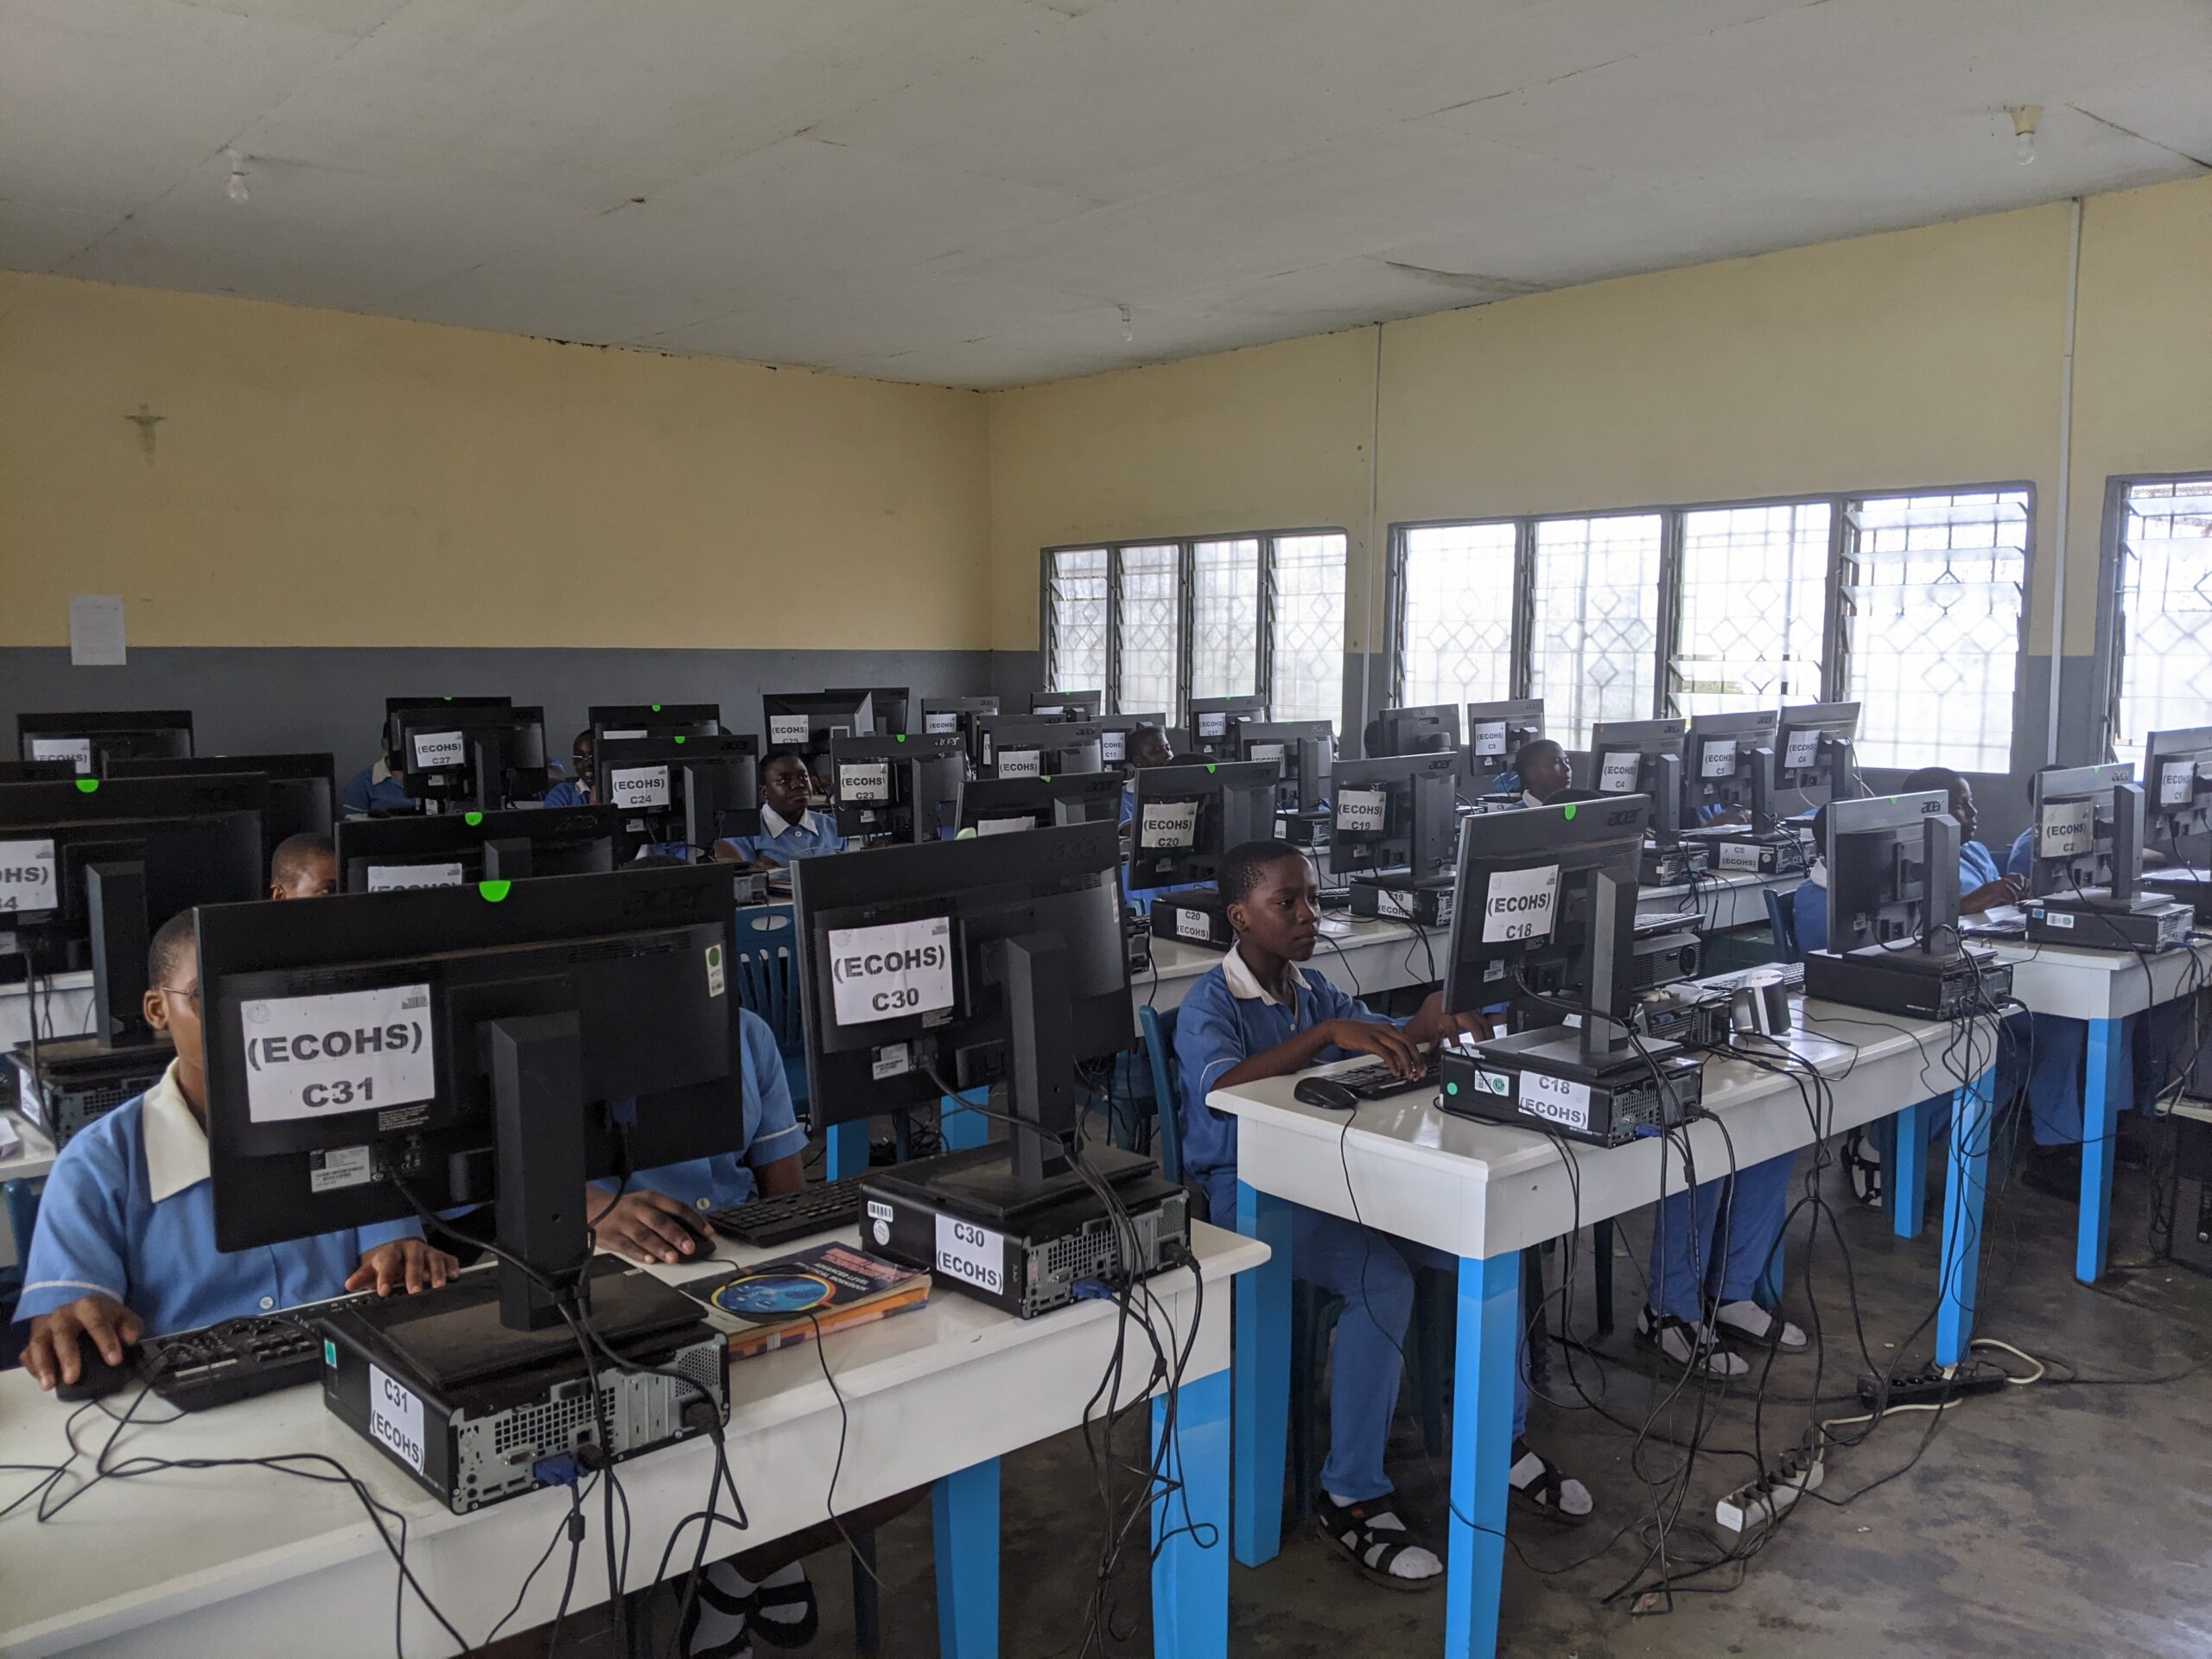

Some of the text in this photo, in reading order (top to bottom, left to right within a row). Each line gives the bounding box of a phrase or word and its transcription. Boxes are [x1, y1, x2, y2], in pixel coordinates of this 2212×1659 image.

[772, 727, 808, 735] (ECOHS)
[1476, 732, 1503, 741] (ECOHS)
[417, 743, 461, 755] (ECOHS)
[432, 756, 451, 765] C27
[999, 763, 1038, 772] (ECOHS)
[614, 779, 664, 792] (ECOHS)
[842, 778, 886, 788] (ECOHS)
[630, 795, 652, 804] C24
[1338, 804, 1382, 817] (ECOHS)
[1143, 819, 1192, 832] (ECOHS)
[2046, 823, 2087, 838] (ECOHS)
[1158, 837, 1179, 847] C20
[1722, 858, 1756, 868] (ECOHS)
[1488, 893, 1551, 917] (ECOHS)
[1185, 911, 1201, 921] C20
[1177, 925, 1209, 940] (ECOHS)
[1506, 923, 1533, 939] C18
[834, 944, 946, 983] (ECOHS)
[872, 988, 920, 1012] C30
[247, 1020, 423, 1071] (ECOHS)
[302, 1077, 374, 1108] C31
[1539, 1076, 1571, 1095] C18
[1520, 1096, 1587, 1128] (ECOHS)
[954, 1222, 985, 1249] C30
[938, 1249, 1003, 1294] (ECOHS)
[384, 1377, 408, 1414] C31
[372, 1409, 425, 1473] (ECOHS)
